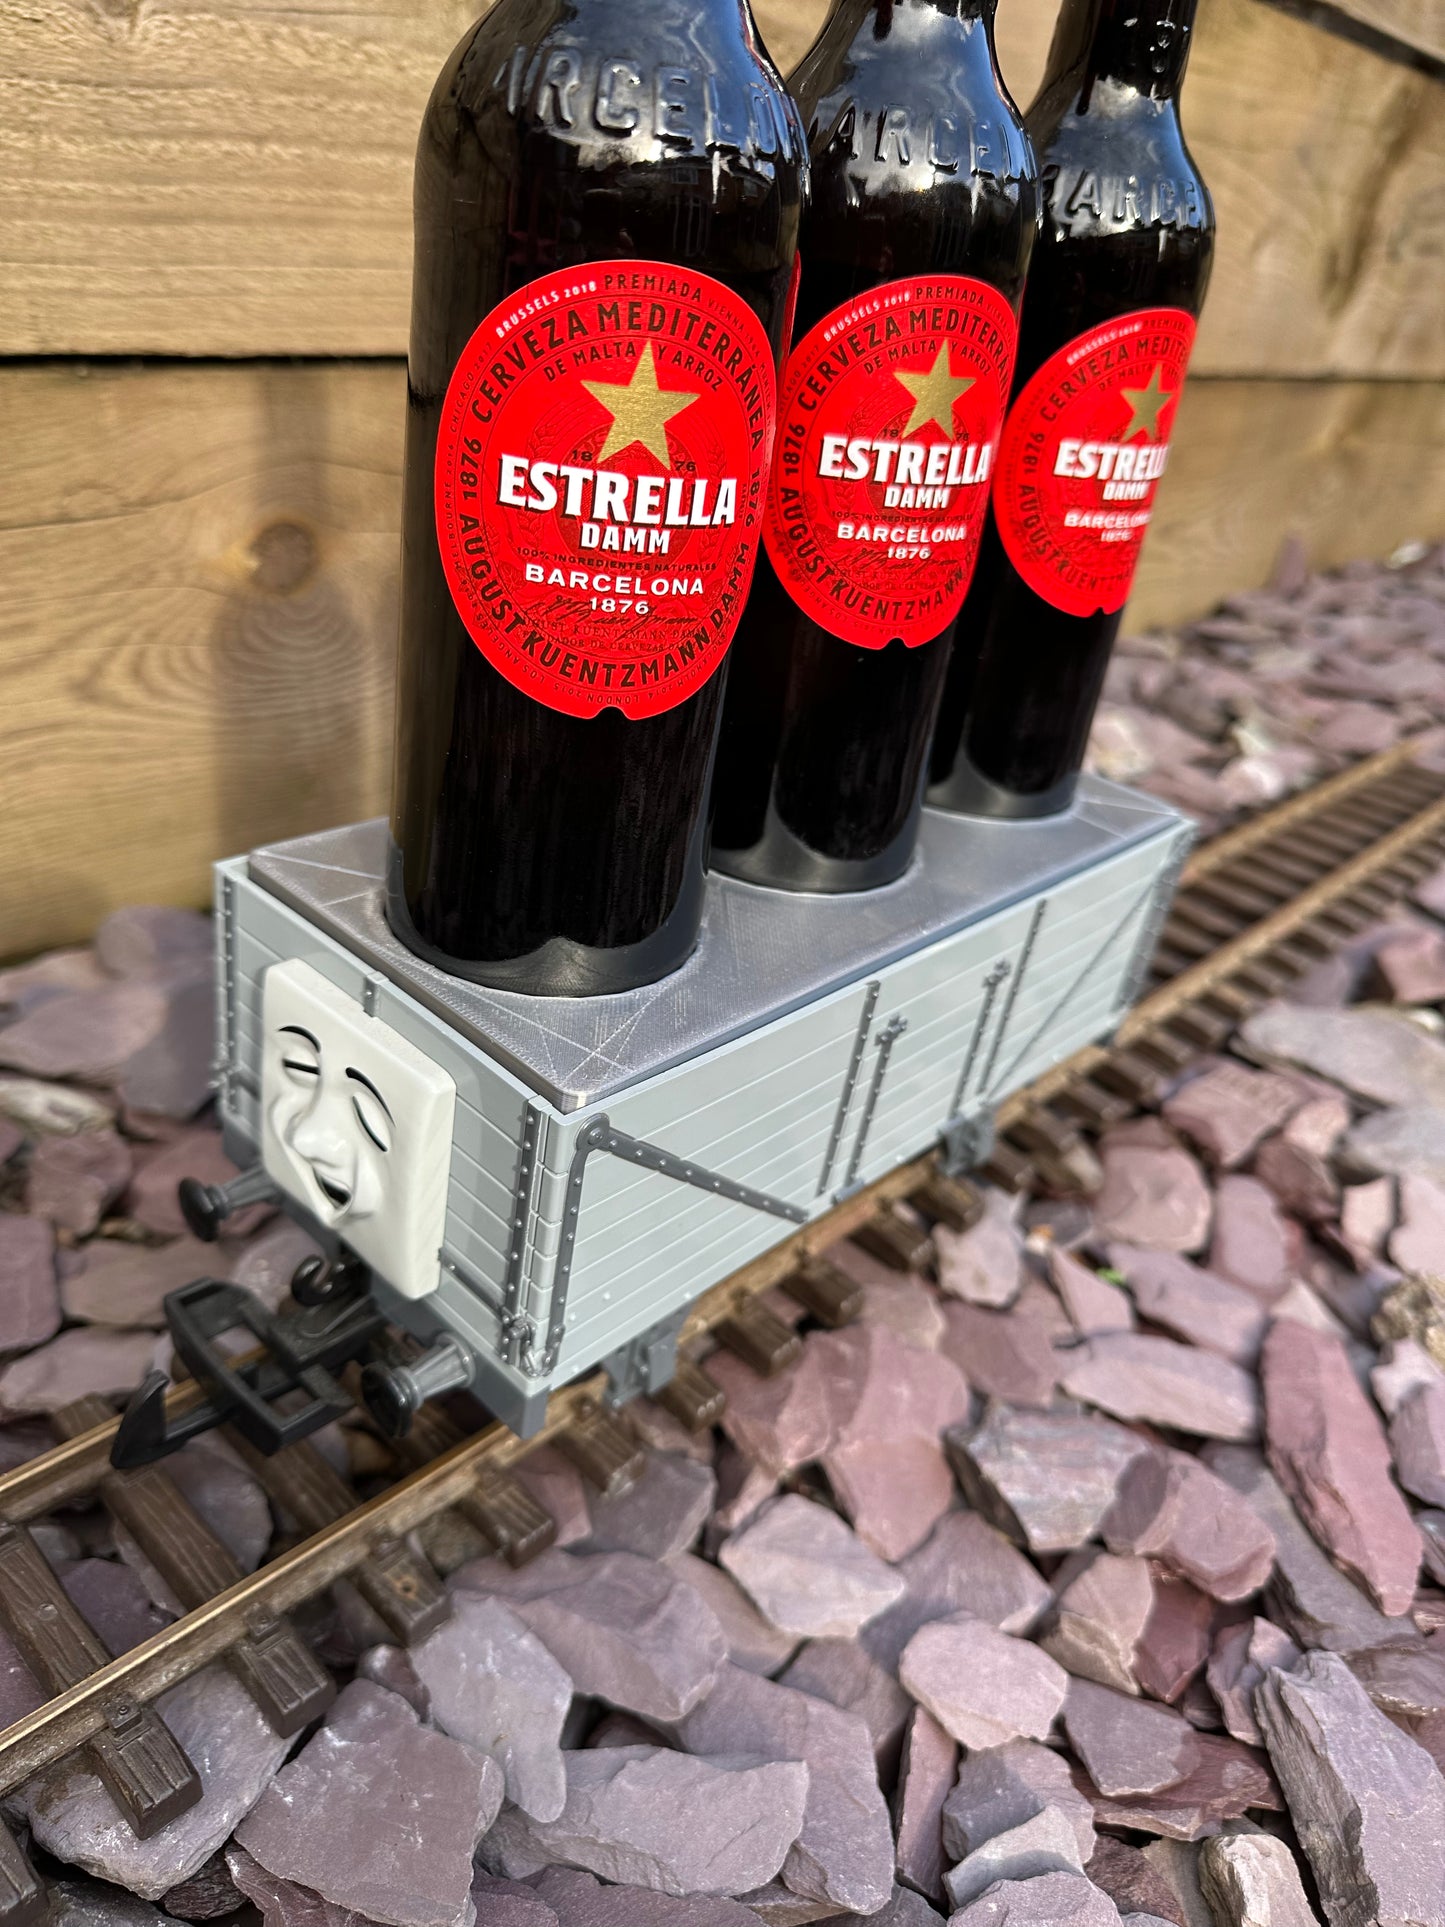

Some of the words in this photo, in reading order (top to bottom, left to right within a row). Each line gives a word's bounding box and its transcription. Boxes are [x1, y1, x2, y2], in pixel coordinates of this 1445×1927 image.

[495, 291, 560, 339] BRUSSELS
[564, 281, 597, 298] 2018
[604, 274, 702, 302] PREMIADA
[916, 286, 985, 305] PREMIADA
[823, 300, 881, 342] BRUSSELS
[471, 309, 589, 423] CERVEZA
[597, 301, 765, 450] MEDITERRÁNEA
[543, 359, 568, 381] DE
[573, 342, 637, 368] MALTA
[657, 344, 667, 360] Y
[671, 351, 723, 392] ARROZ
[797, 315, 902, 412] CERVEZA
[863, 356, 883, 375] DE
[887, 340, 937, 361] MALTA
[951, 342, 958, 353] Y
[960, 345, 992, 376] ARROZ
[1039, 344, 1129, 423] CERVEZA
[460, 436, 483, 500] 1876
[783, 423, 806, 477] 1876
[818, 435, 991, 485] ESTRELLA
[497, 453, 738, 528] ESTRELLA
[746, 467, 761, 528] 1876
[884, 487, 951, 508] DAMM
[580, 522, 671, 556] DAMM
[837, 522, 967, 543] BARCELONA
[1019, 484, 1061, 563] AUGUST
[553, 553, 650, 571] INGREDIENTES
[780, 487, 835, 584] AUGUST
[829, 566, 963, 621] KUENTZMANN
[886, 545, 932, 560] 1876
[459, 513, 527, 634] AUGUST
[521, 626, 711, 688] KUENTZMANN
[709, 543, 750, 630] DAMM
[525, 563, 704, 596] BARCELONA
[589, 597, 649, 615] 1876
